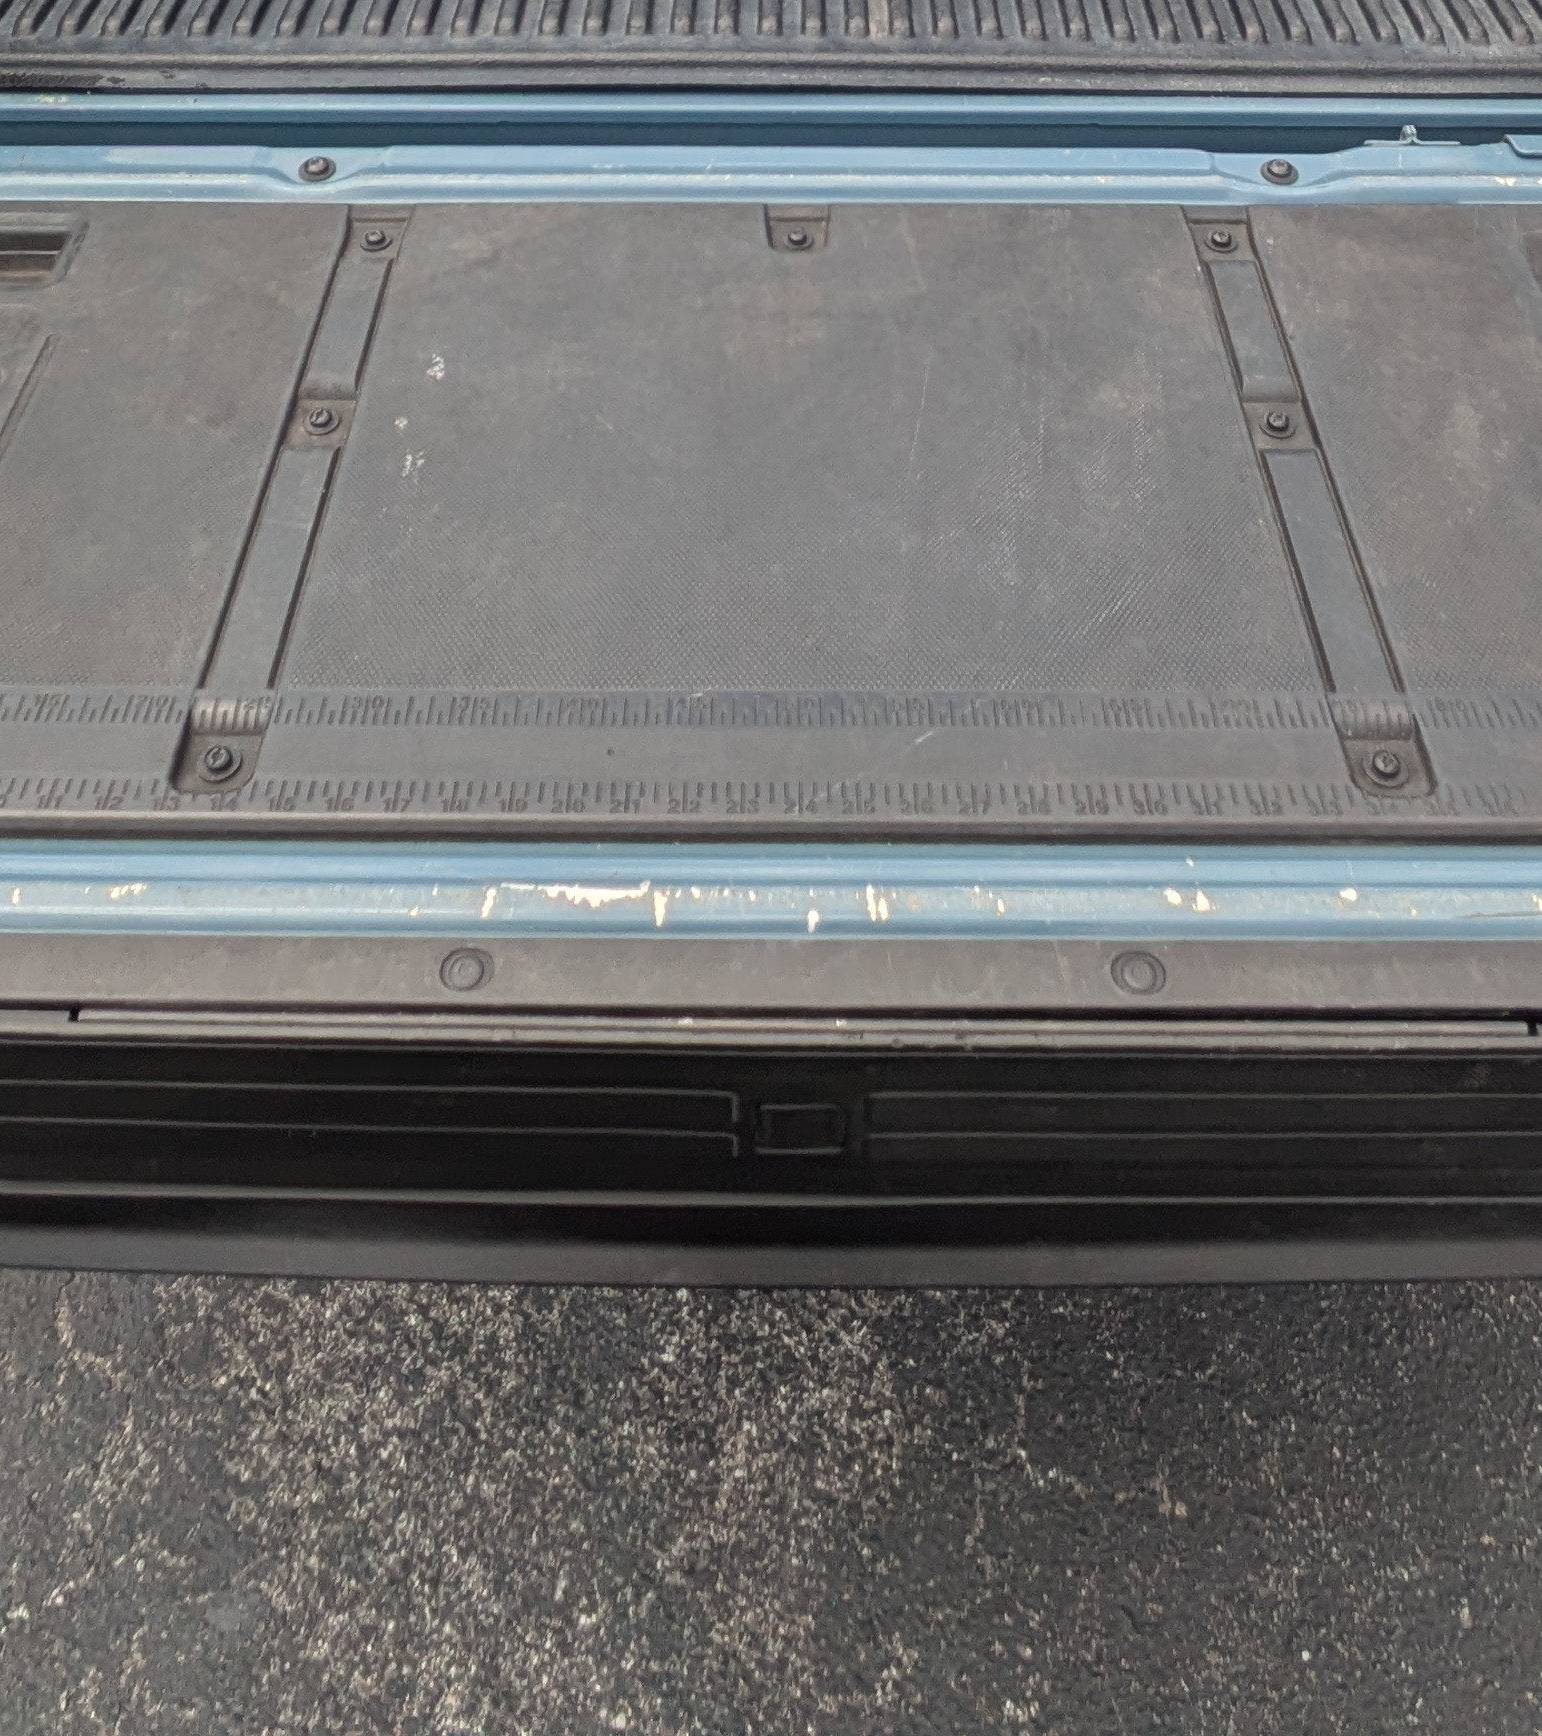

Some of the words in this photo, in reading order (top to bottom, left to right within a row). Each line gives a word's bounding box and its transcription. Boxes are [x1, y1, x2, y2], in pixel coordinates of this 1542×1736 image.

[37, 794, 64, 811] 11
[95, 796, 125, 811] 12
[153, 796, 181, 811] 13
[269, 797, 296, 812] 15
[326, 797, 355, 812] 16
[383, 797, 410, 813] 17
[499, 798, 528, 813] 19
[551, 798, 586, 814] 20
[610, 799, 642, 814] 21
[668, 799, 701, 814] 22
[726, 799, 760, 814] 23
